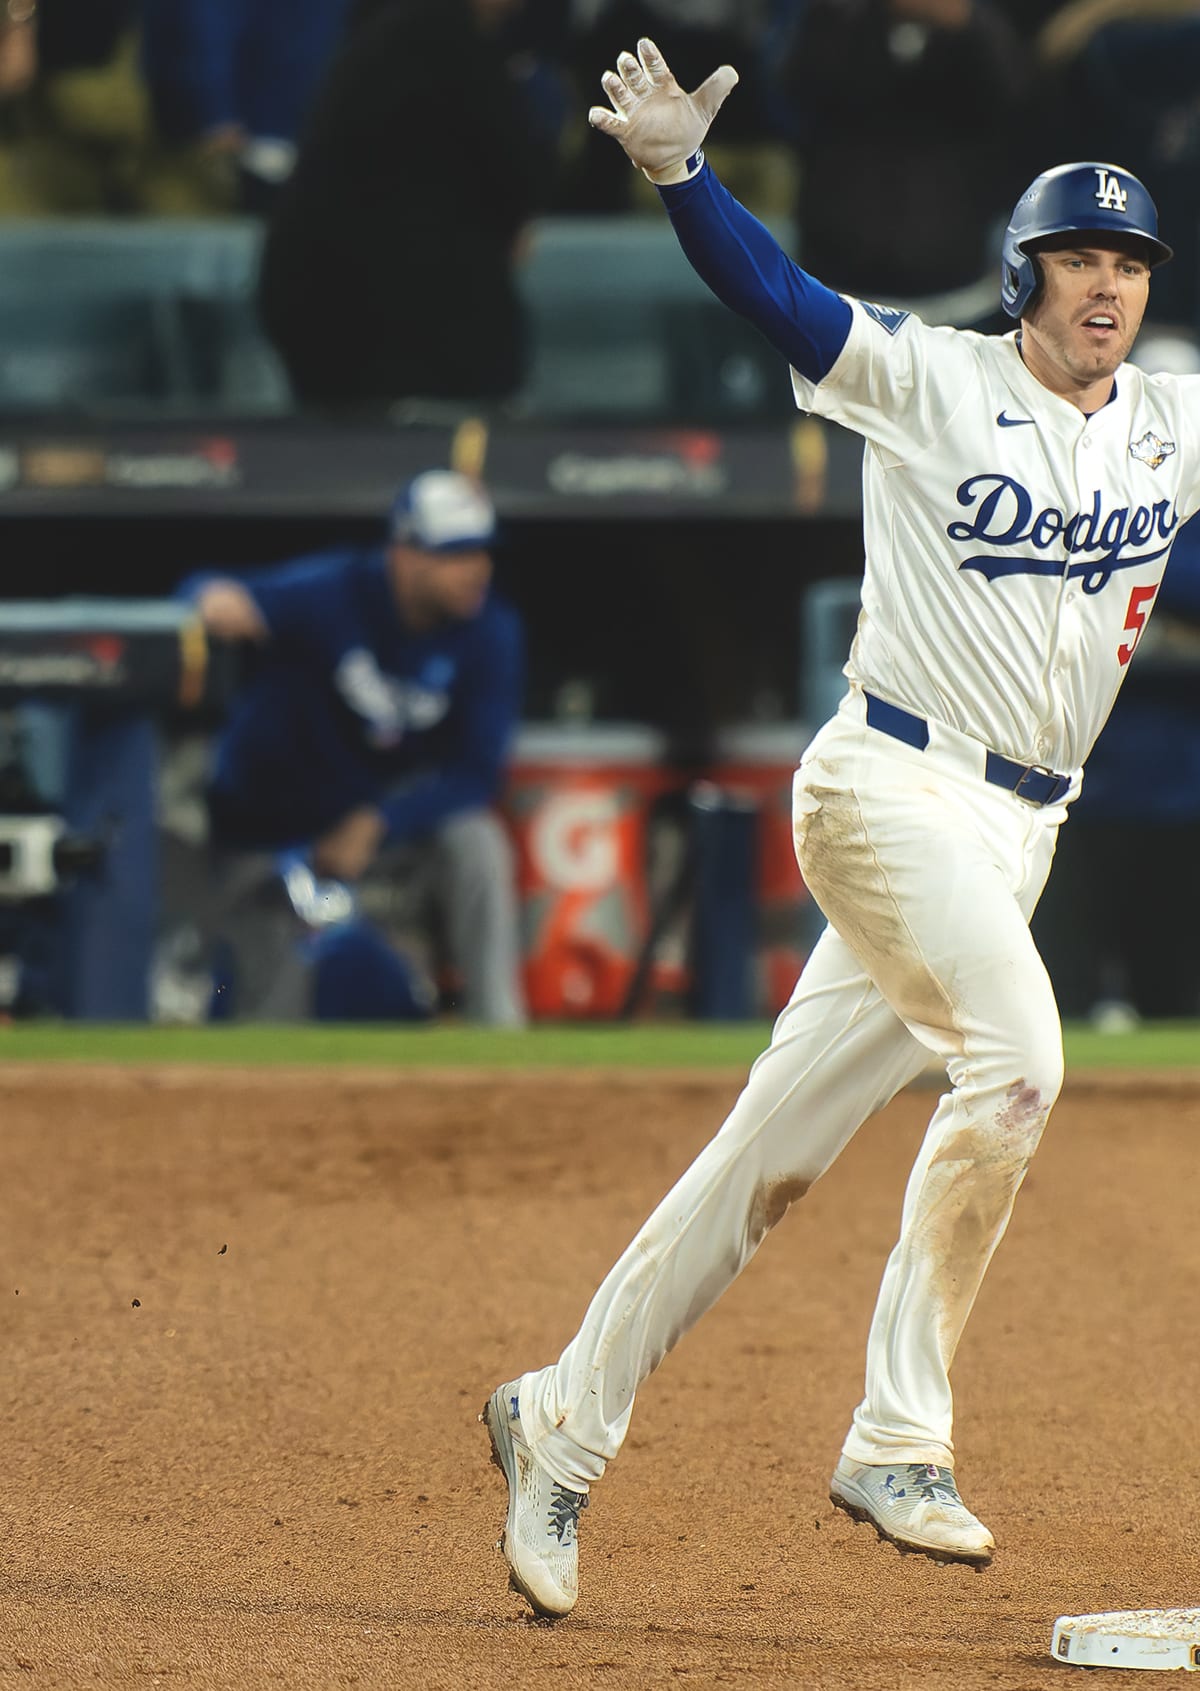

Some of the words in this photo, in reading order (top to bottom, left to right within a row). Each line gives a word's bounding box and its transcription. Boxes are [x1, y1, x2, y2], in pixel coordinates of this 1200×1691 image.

[1094, 168, 1128, 212] LA
[946, 473, 1179, 595] Dodger
[1116, 583, 1160, 667] 5
